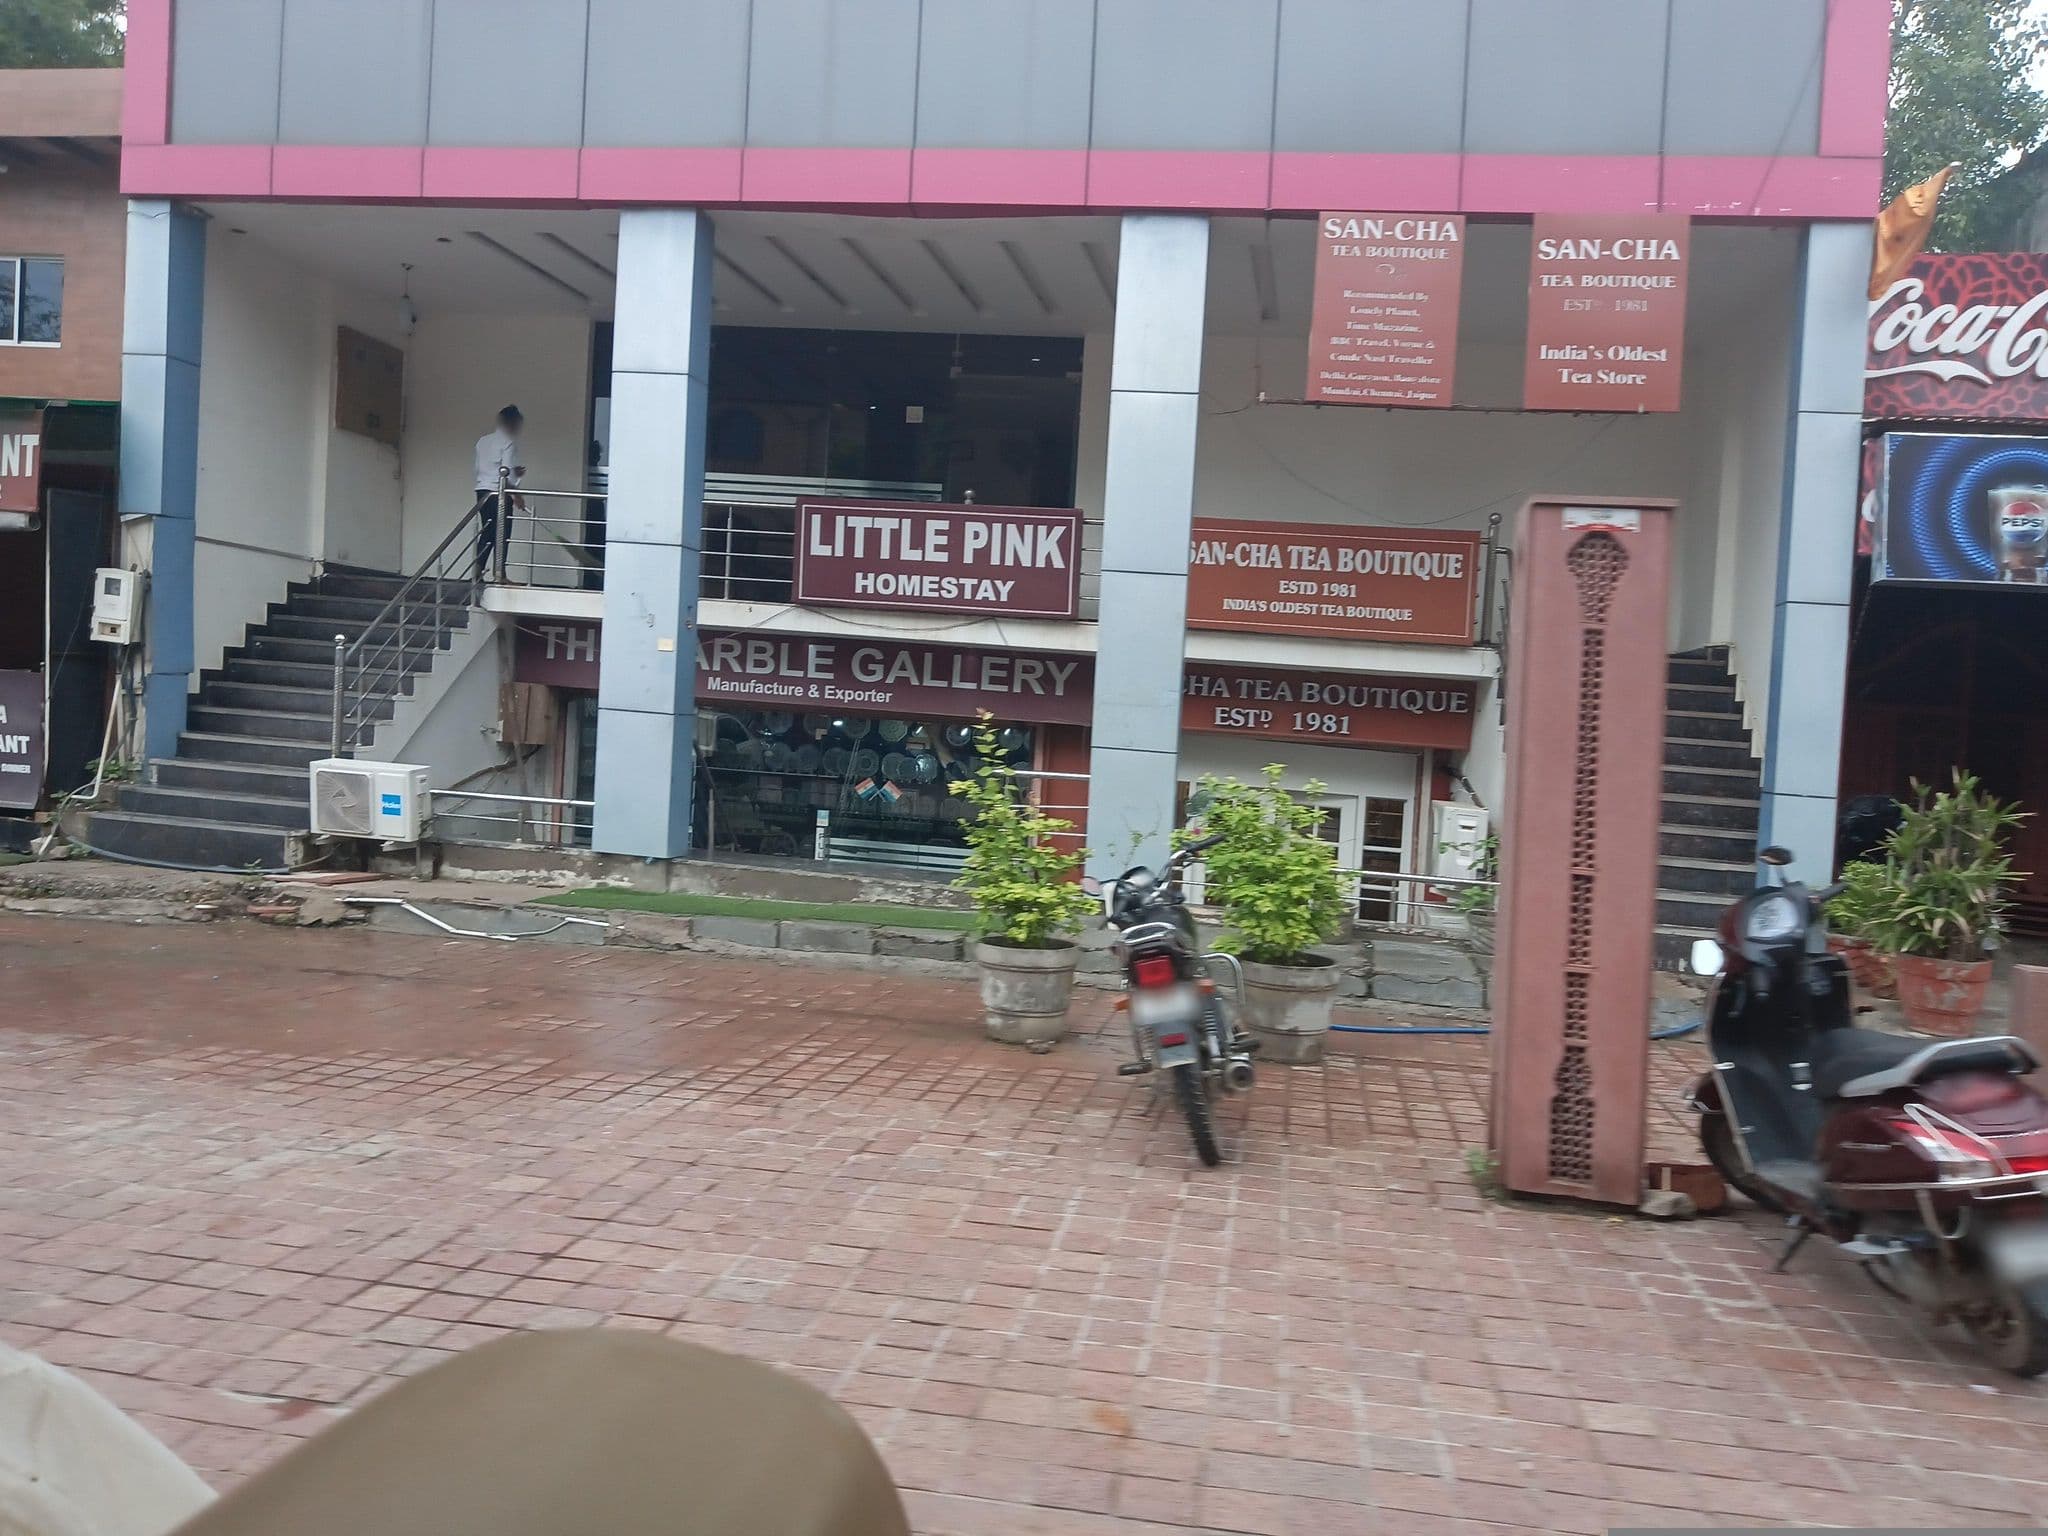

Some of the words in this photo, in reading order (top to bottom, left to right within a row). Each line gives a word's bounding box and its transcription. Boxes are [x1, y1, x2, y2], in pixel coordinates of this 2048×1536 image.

[1324, 218, 1459, 242] SAN-CHA
[1330, 244, 1362, 257] TEA
[1366, 246, 1449, 261] BOUTIQUE
[1538, 238, 1681, 261] SAN-CHA
[1539, 274, 1575, 288] TEA
[1581, 274, 1678, 290] BOUTIQUE
[1539, 344, 1604, 361] India's
[1607, 345, 1668, 362] Oldest
[1557, 368, 1593, 384] Tea
[1596, 369, 1648, 385] Store
[0, 433, 40, 477] NT
[809, 513, 950, 563] LITTLE
[962, 520, 1068, 569] PINK
[1287, 545, 1332, 572] TEA
[1335, 548, 1464, 581] BOUTIQUE
[854, 571, 1016, 602] HOMESTAY
[1278, 580, 1318, 595] ESTD
[1321, 582, 1358, 598] 1981
[1222, 598, 1267, 613] INDIA'S
[1269, 601, 1319, 616] OLDEST
[1319, 604, 1344, 618] TEA
[1345, 606, 1413, 621] BOUTIQUE
[538, 626, 596, 663] TH
[850, 647, 1079, 697] GALLERY
[707, 676, 804, 697] Manufacture
[807, 683, 820, 699] &
[823, 685, 893, 704] Exporter
[1235, 678, 1294, 702] TEA
[1299, 682, 1470, 715] BOUTIQUE
[1292, 711, 1351, 735] 1981
